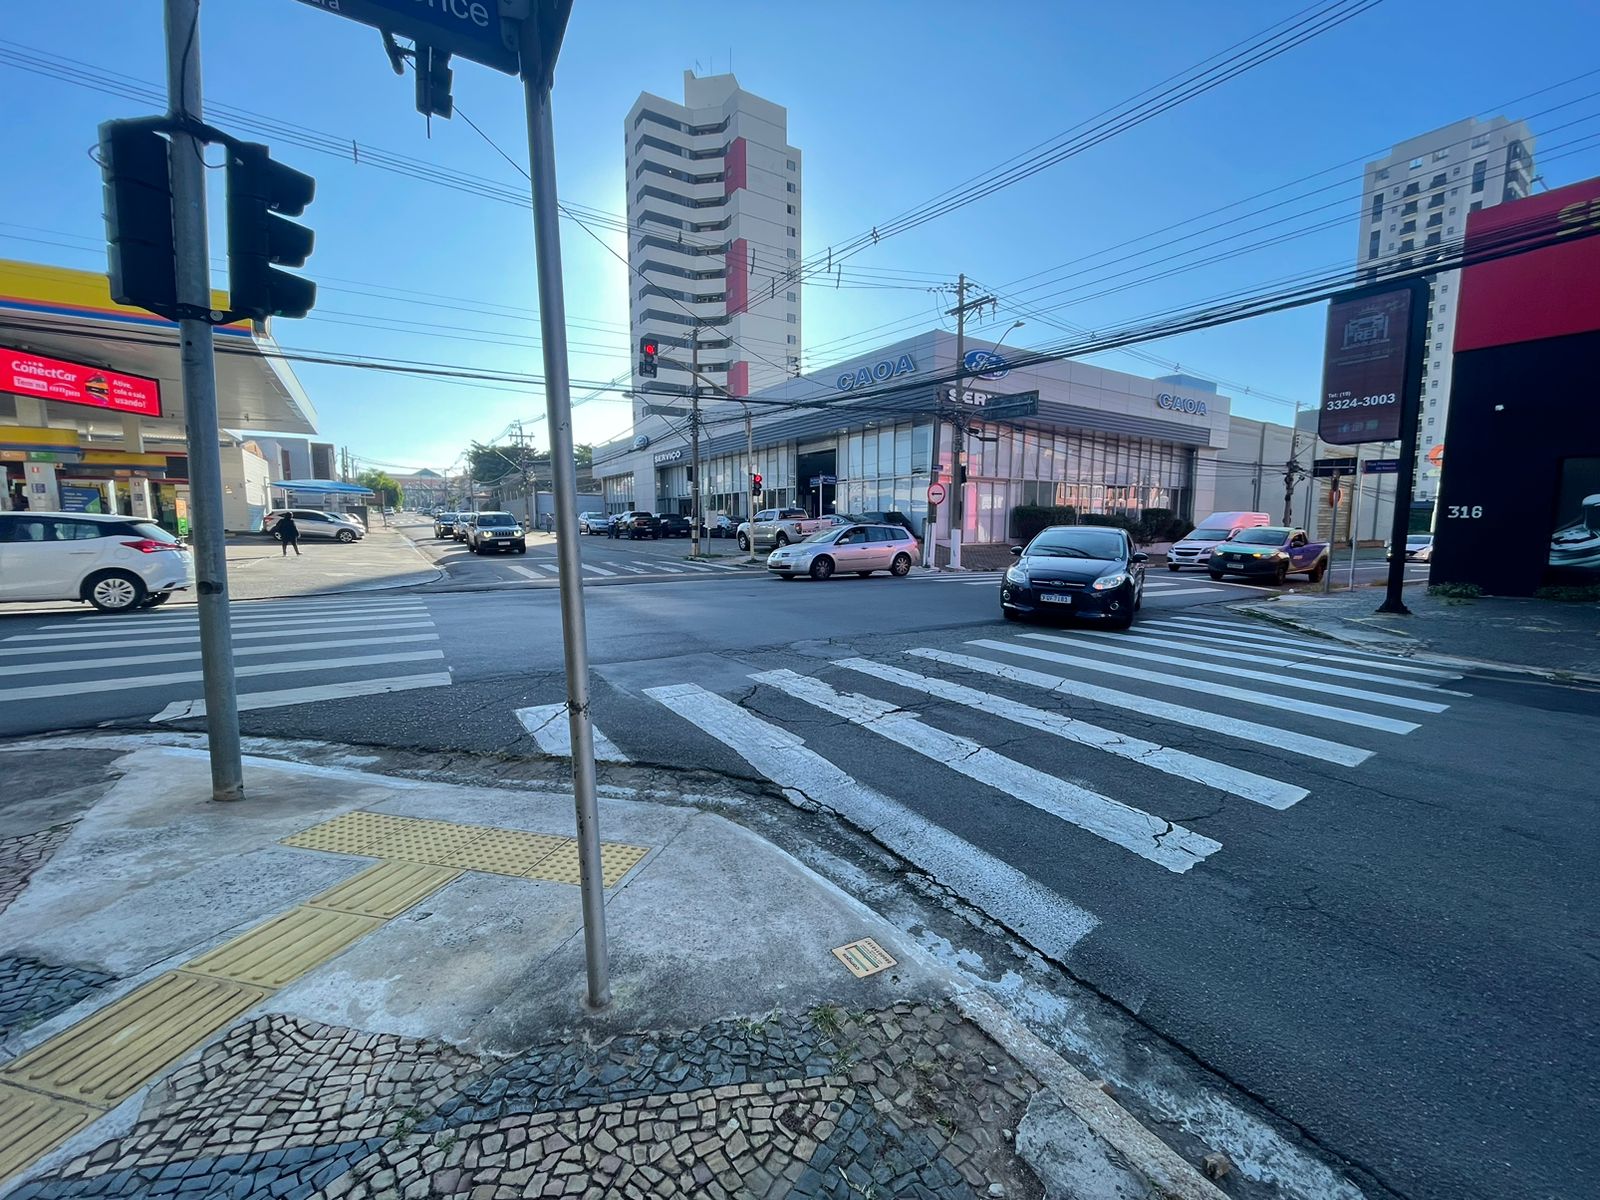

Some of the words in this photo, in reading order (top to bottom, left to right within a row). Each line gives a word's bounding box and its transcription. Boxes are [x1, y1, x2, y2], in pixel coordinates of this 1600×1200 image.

[11, 360, 78, 382] ConectCar
[835, 353, 917, 392] CAOA
[948, 387, 993, 407] SER
[1157, 392, 1208, 416] CAOA
[1326, 392, 1396, 411] 3324-3003
[654, 450, 681, 464] SERVIÇO
[1447, 505, 1483, 519] 316
